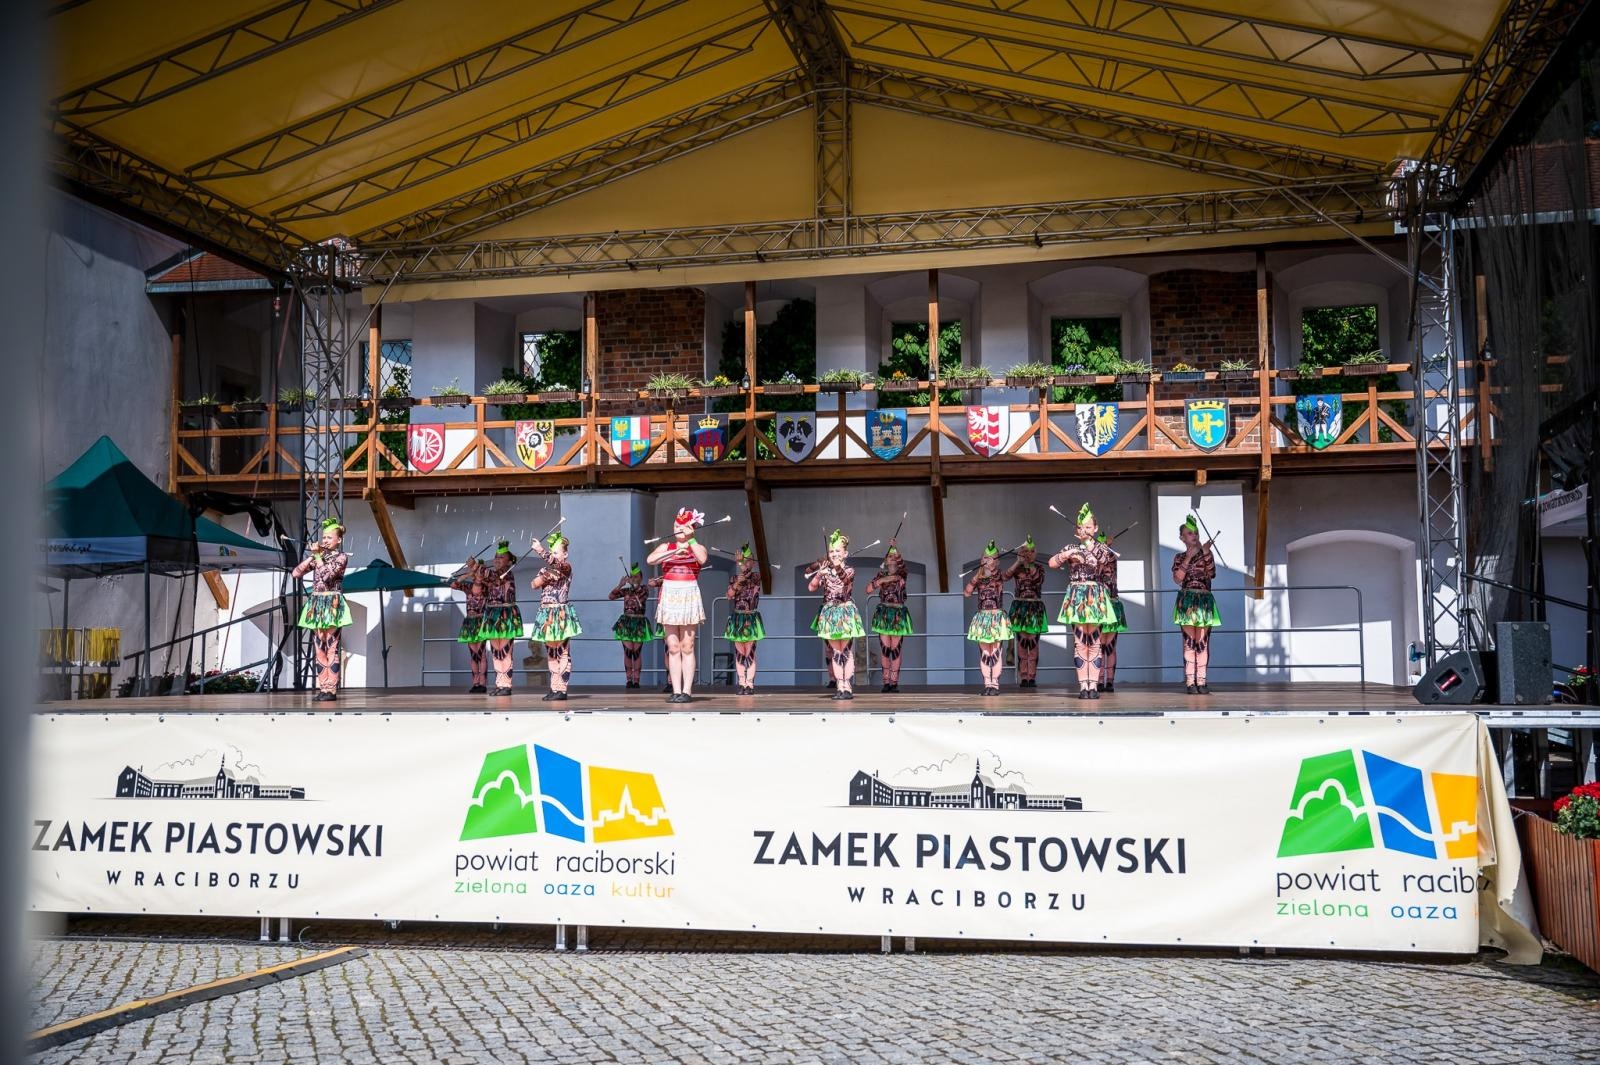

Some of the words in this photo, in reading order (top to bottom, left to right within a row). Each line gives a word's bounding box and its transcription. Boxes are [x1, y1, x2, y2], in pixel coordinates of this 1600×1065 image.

[32, 820, 153, 853] ZAMEK
[164, 822, 383, 857] PIASTOWSKI
[455, 848, 539, 877] powiat
[556, 850, 675, 875] raciborski
[753, 830, 901, 868] ZAMEK
[916, 833, 1187, 875] PIASTOWSKI
[106, 870, 121, 885] W
[134, 871, 299, 889] RACIBORZU
[454, 878, 527, 894] zielona
[543, 882, 595, 897] oaza
[611, 880, 675, 898] kultur
[1276, 866, 1381, 897] powiat
[847, 886, 866, 903] W
[882, 888, 1085, 911] RACIBORZU
[1276, 899, 1369, 917] zielona
[1390, 904, 1458, 920] oaza
